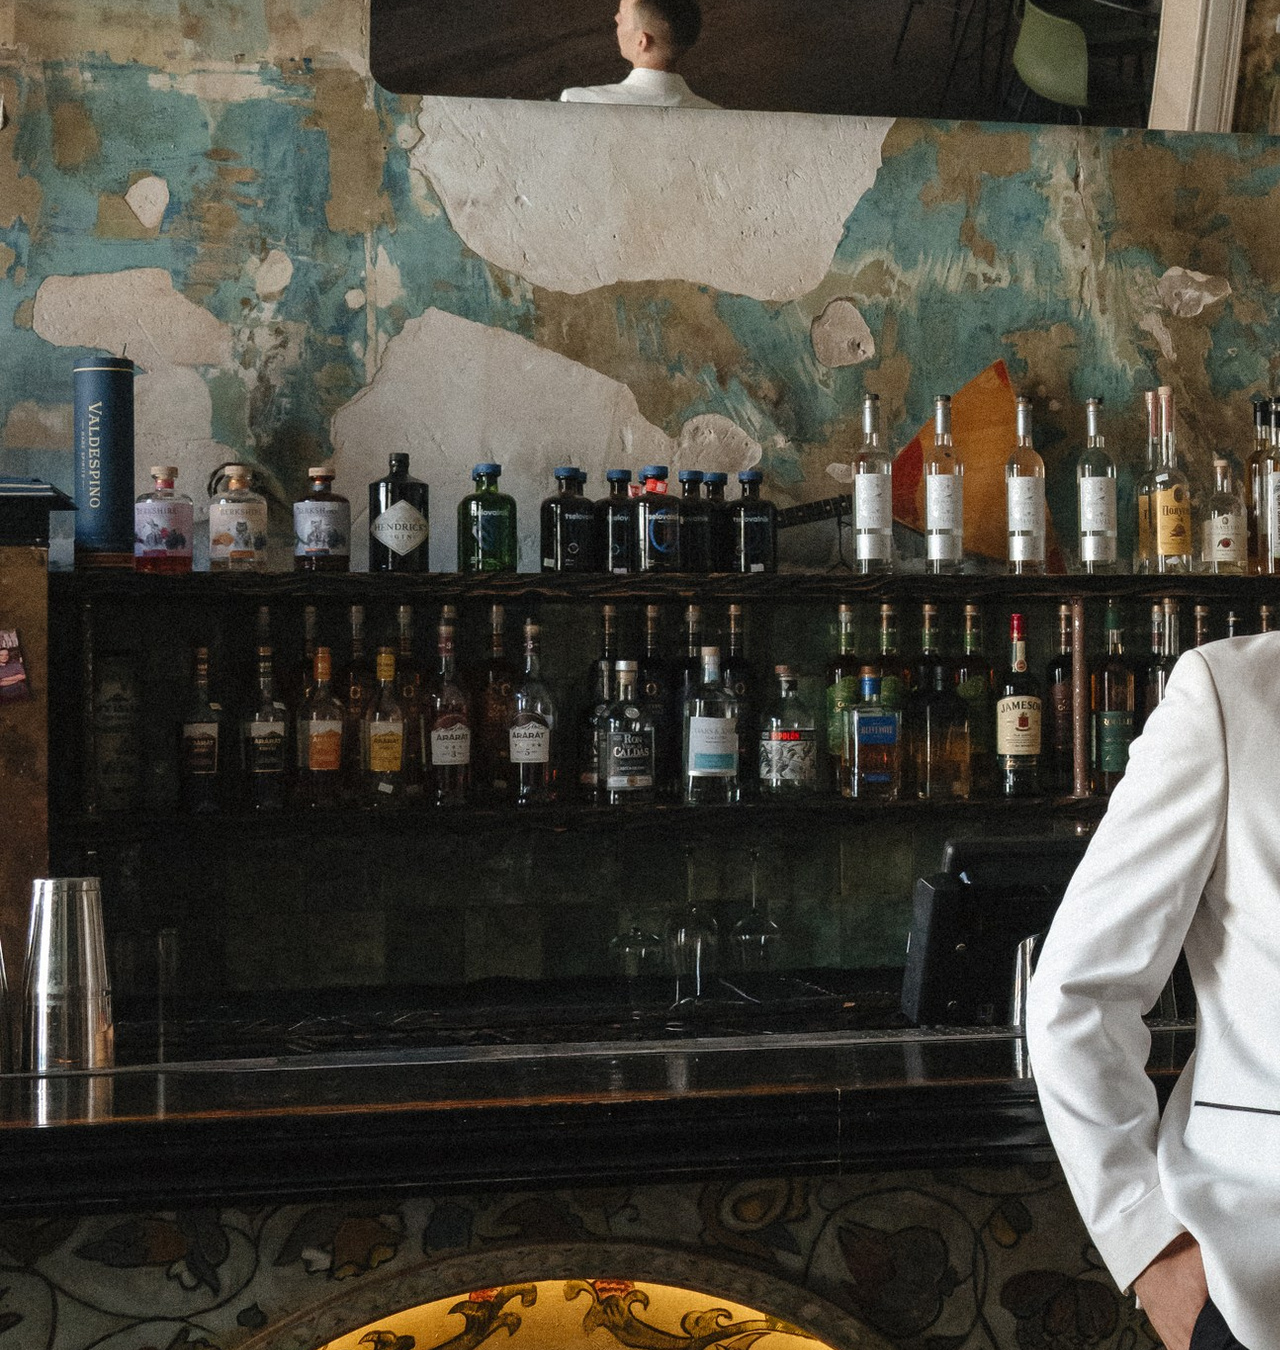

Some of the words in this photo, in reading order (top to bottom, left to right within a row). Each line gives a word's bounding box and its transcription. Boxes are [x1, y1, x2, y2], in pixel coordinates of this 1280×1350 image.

[88, 401, 102, 508] VALDESPINO
[436, 733, 468, 741] ARARAT
[624, 734, 643, 744] RON
[613, 747, 649, 757] CALDAS
